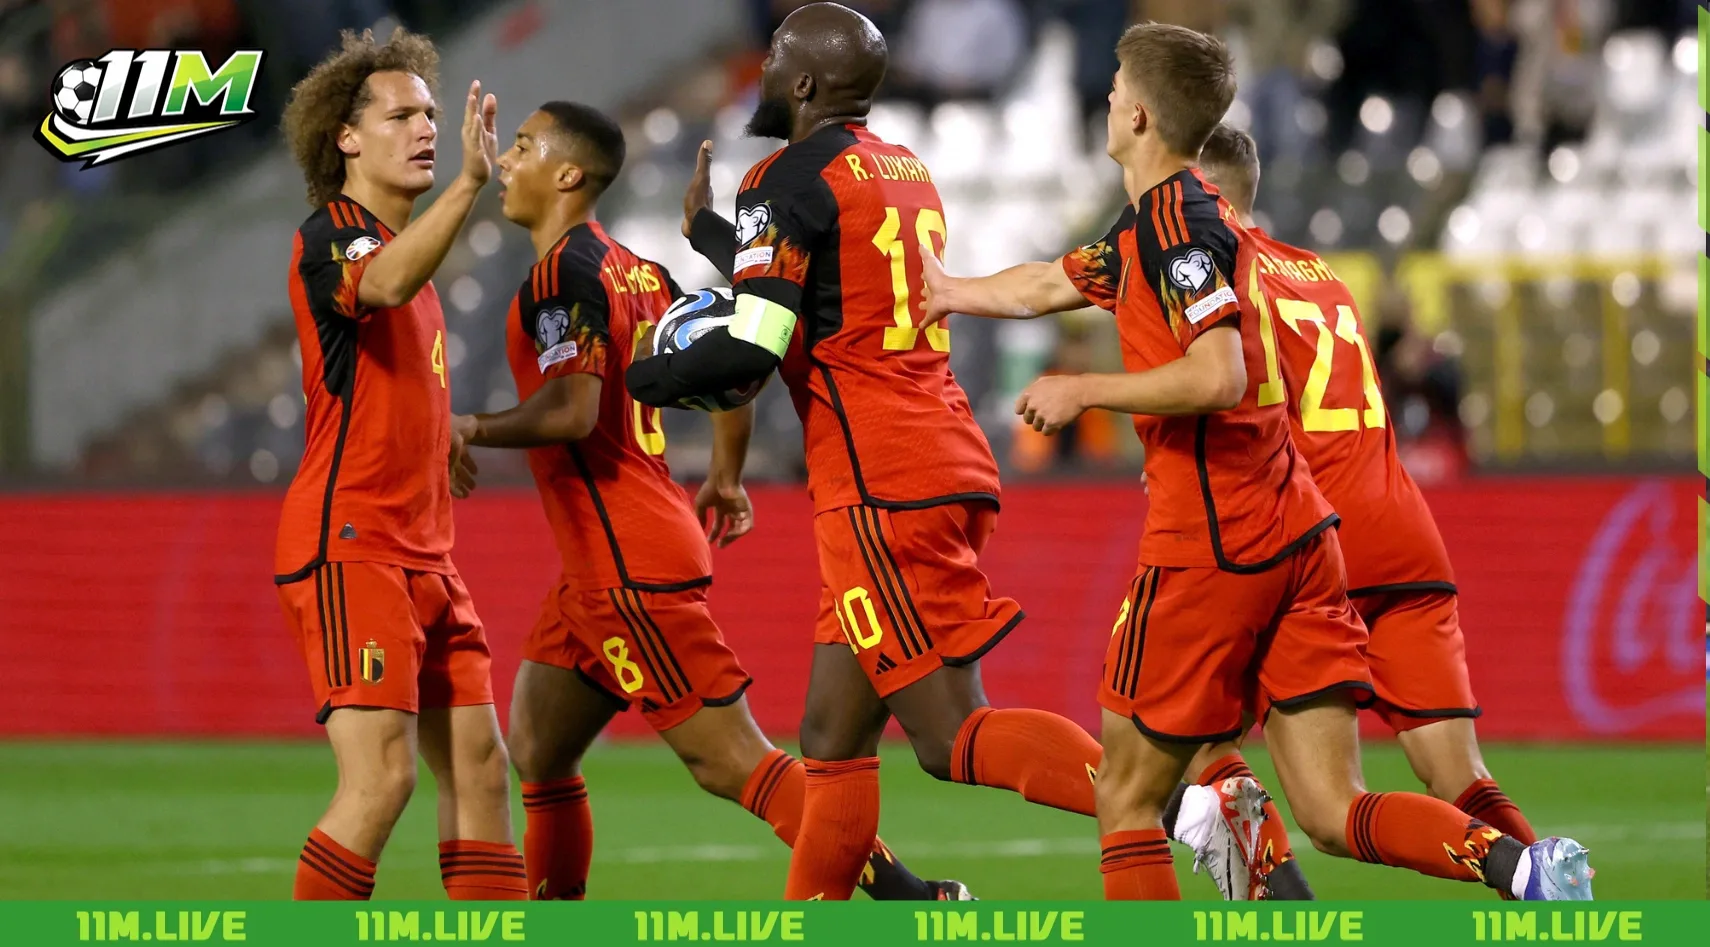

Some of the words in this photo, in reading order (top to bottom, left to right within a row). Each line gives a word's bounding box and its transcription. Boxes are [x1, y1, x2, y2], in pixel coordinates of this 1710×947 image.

[845, 154, 875, 181] R.
[871, 154, 932, 183] LUKAK
[871, 207, 950, 353] 10
[431, 330, 446, 389] 4
[1275, 298, 1386, 431] 21
[602, 636, 644, 694] 8
